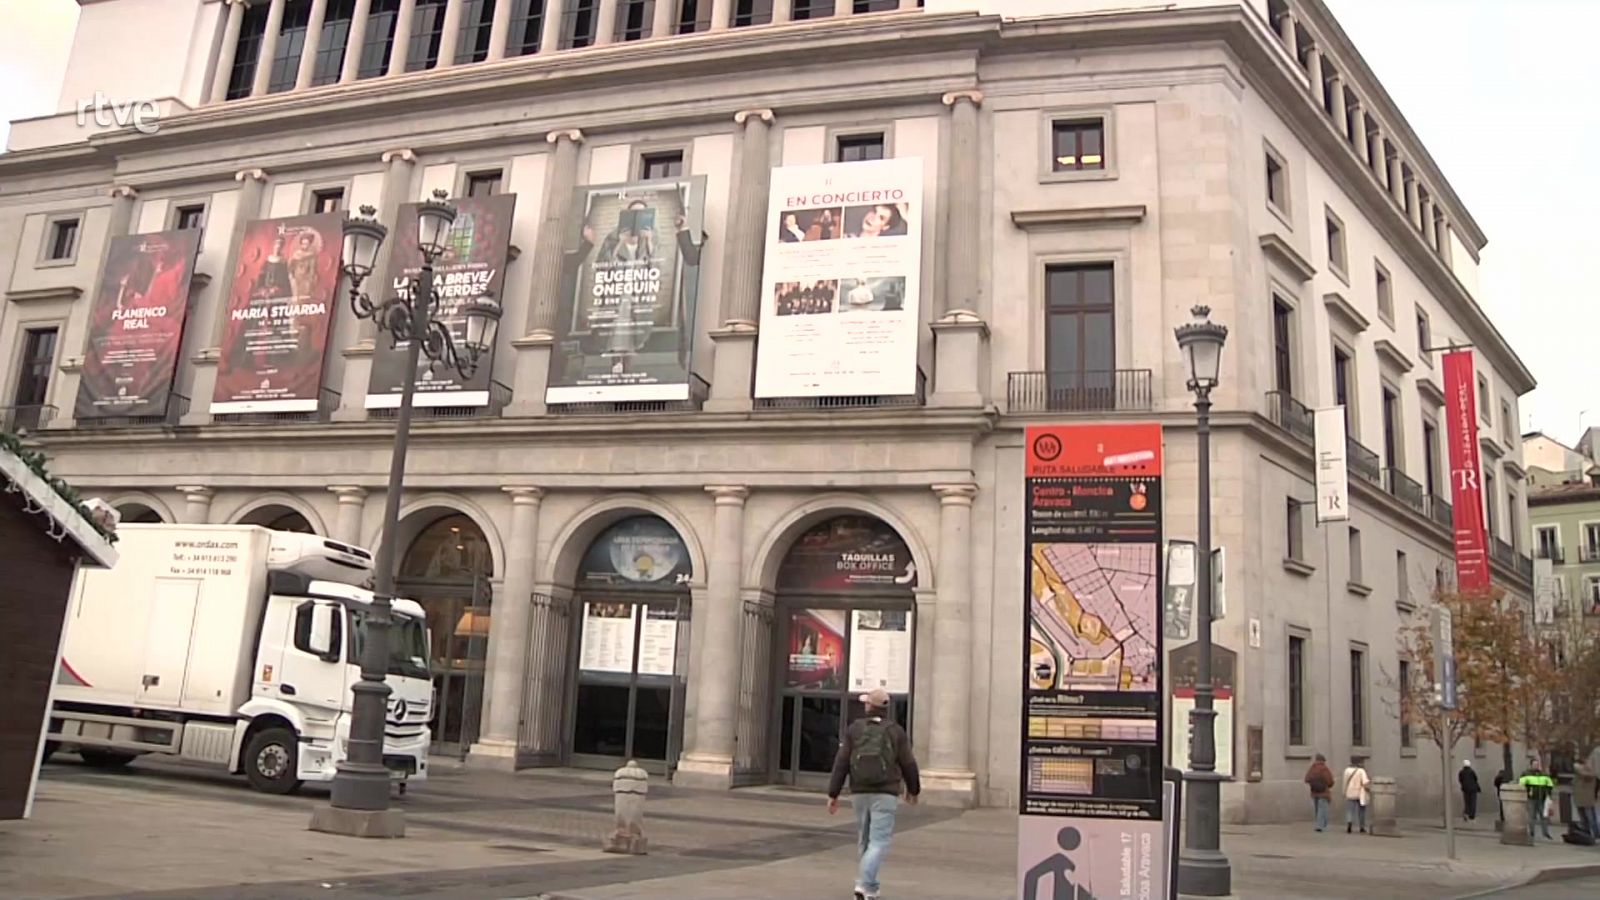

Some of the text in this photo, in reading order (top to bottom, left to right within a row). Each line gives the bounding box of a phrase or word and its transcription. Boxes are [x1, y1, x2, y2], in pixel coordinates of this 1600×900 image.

[787, 189, 903, 207] EN CONCIERTO
[595, 268, 660, 284] EUGENIO
[437, 283, 488, 297] VERDES
[112, 306, 167, 320] FLAMENCO
[270, 303, 326, 318] STUARDA
[123, 318, 150, 330] REAL
[1033, 465, 1057, 474] RUTA
[841, 553, 896, 562] TAQUILLAS
[836, 561, 894, 571] BOX OFFICE
